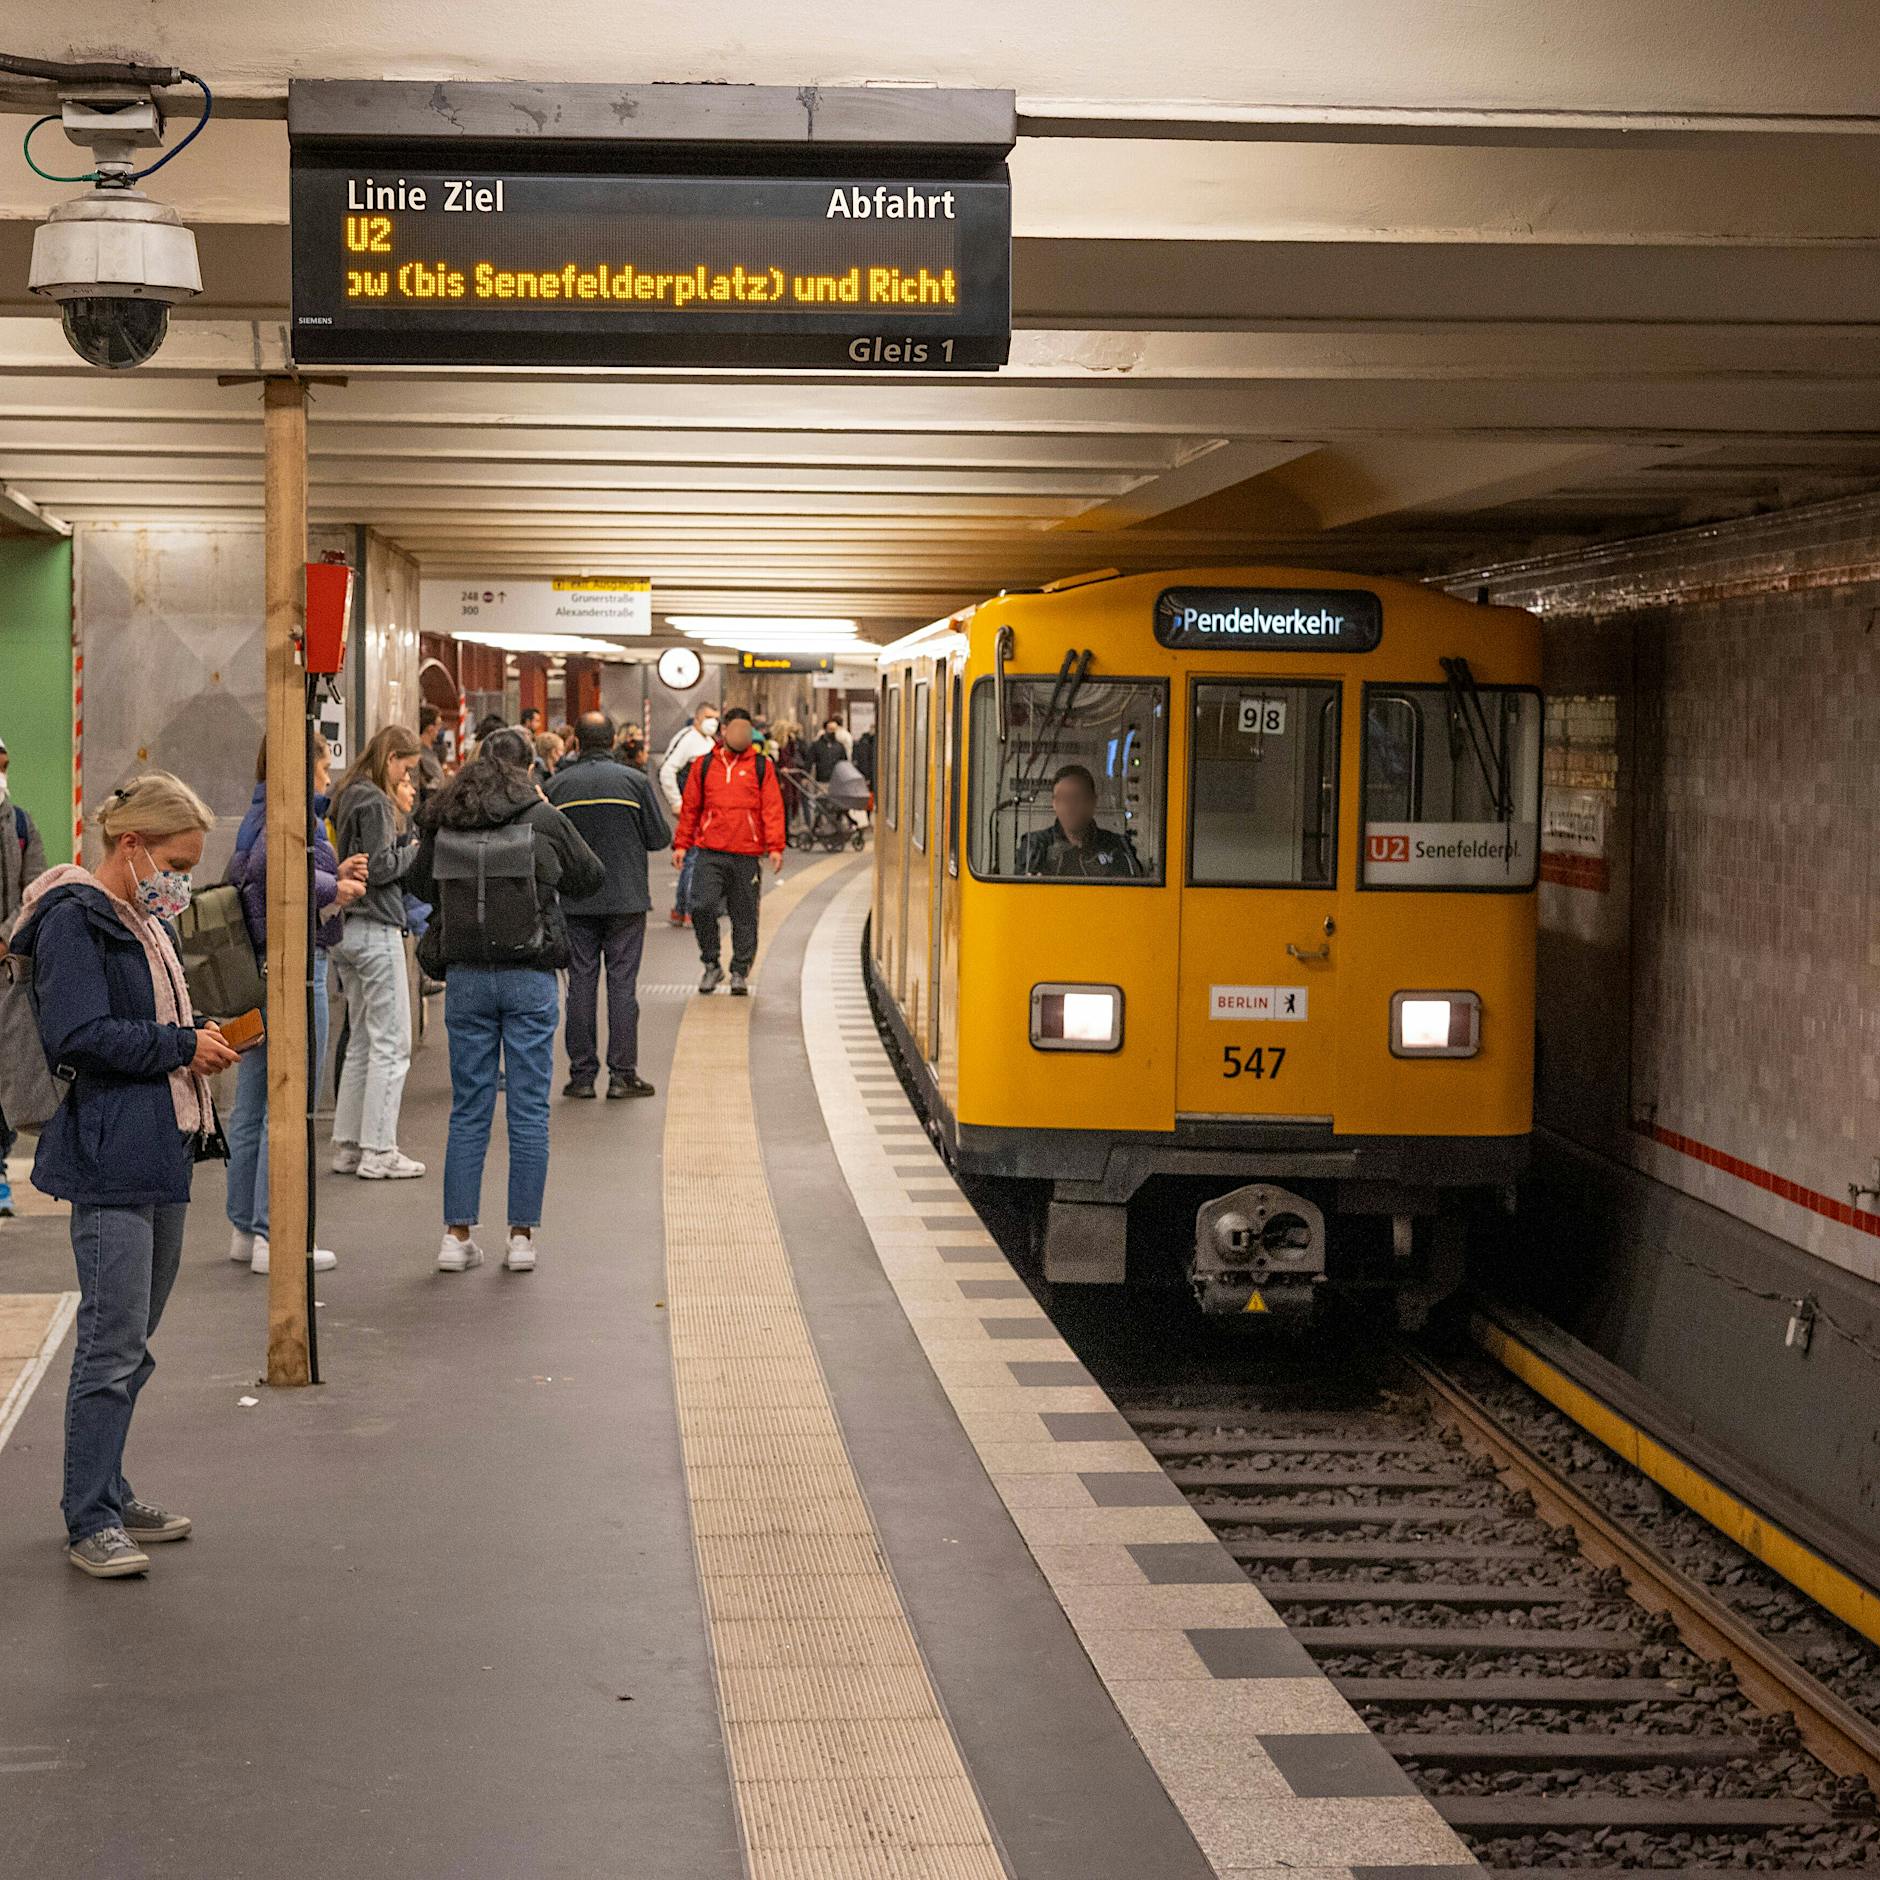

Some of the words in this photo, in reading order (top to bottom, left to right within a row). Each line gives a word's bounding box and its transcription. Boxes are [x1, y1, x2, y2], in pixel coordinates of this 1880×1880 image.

[348, 179, 426, 210] Linie
[444, 180, 504, 212] Ziel
[827, 187, 955, 219] Abfahrt
[347, 217, 391, 251] U2
[399, 263, 465, 297] (bis
[475, 263, 784, 306] Senefelderplatz)
[794, 269, 859, 302] und
[869, 269, 955, 304] Richt
[298, 316, 333, 325] SIEMENS
[849, 338, 928, 362] Gleis
[941, 339, 954, 362] 1
[461, 591, 479, 602] 248
[461, 606, 479, 616] 300
[556, 606, 634, 617] Alexanderstraße
[1183, 607, 1345, 635] Pendelverkehr
[1244, 707, 1280, 730] 98
[1370, 838, 1406, 860] U2
[1217, 995, 1269, 1009] BERLIN
[1222, 1045, 1287, 1080] 547
